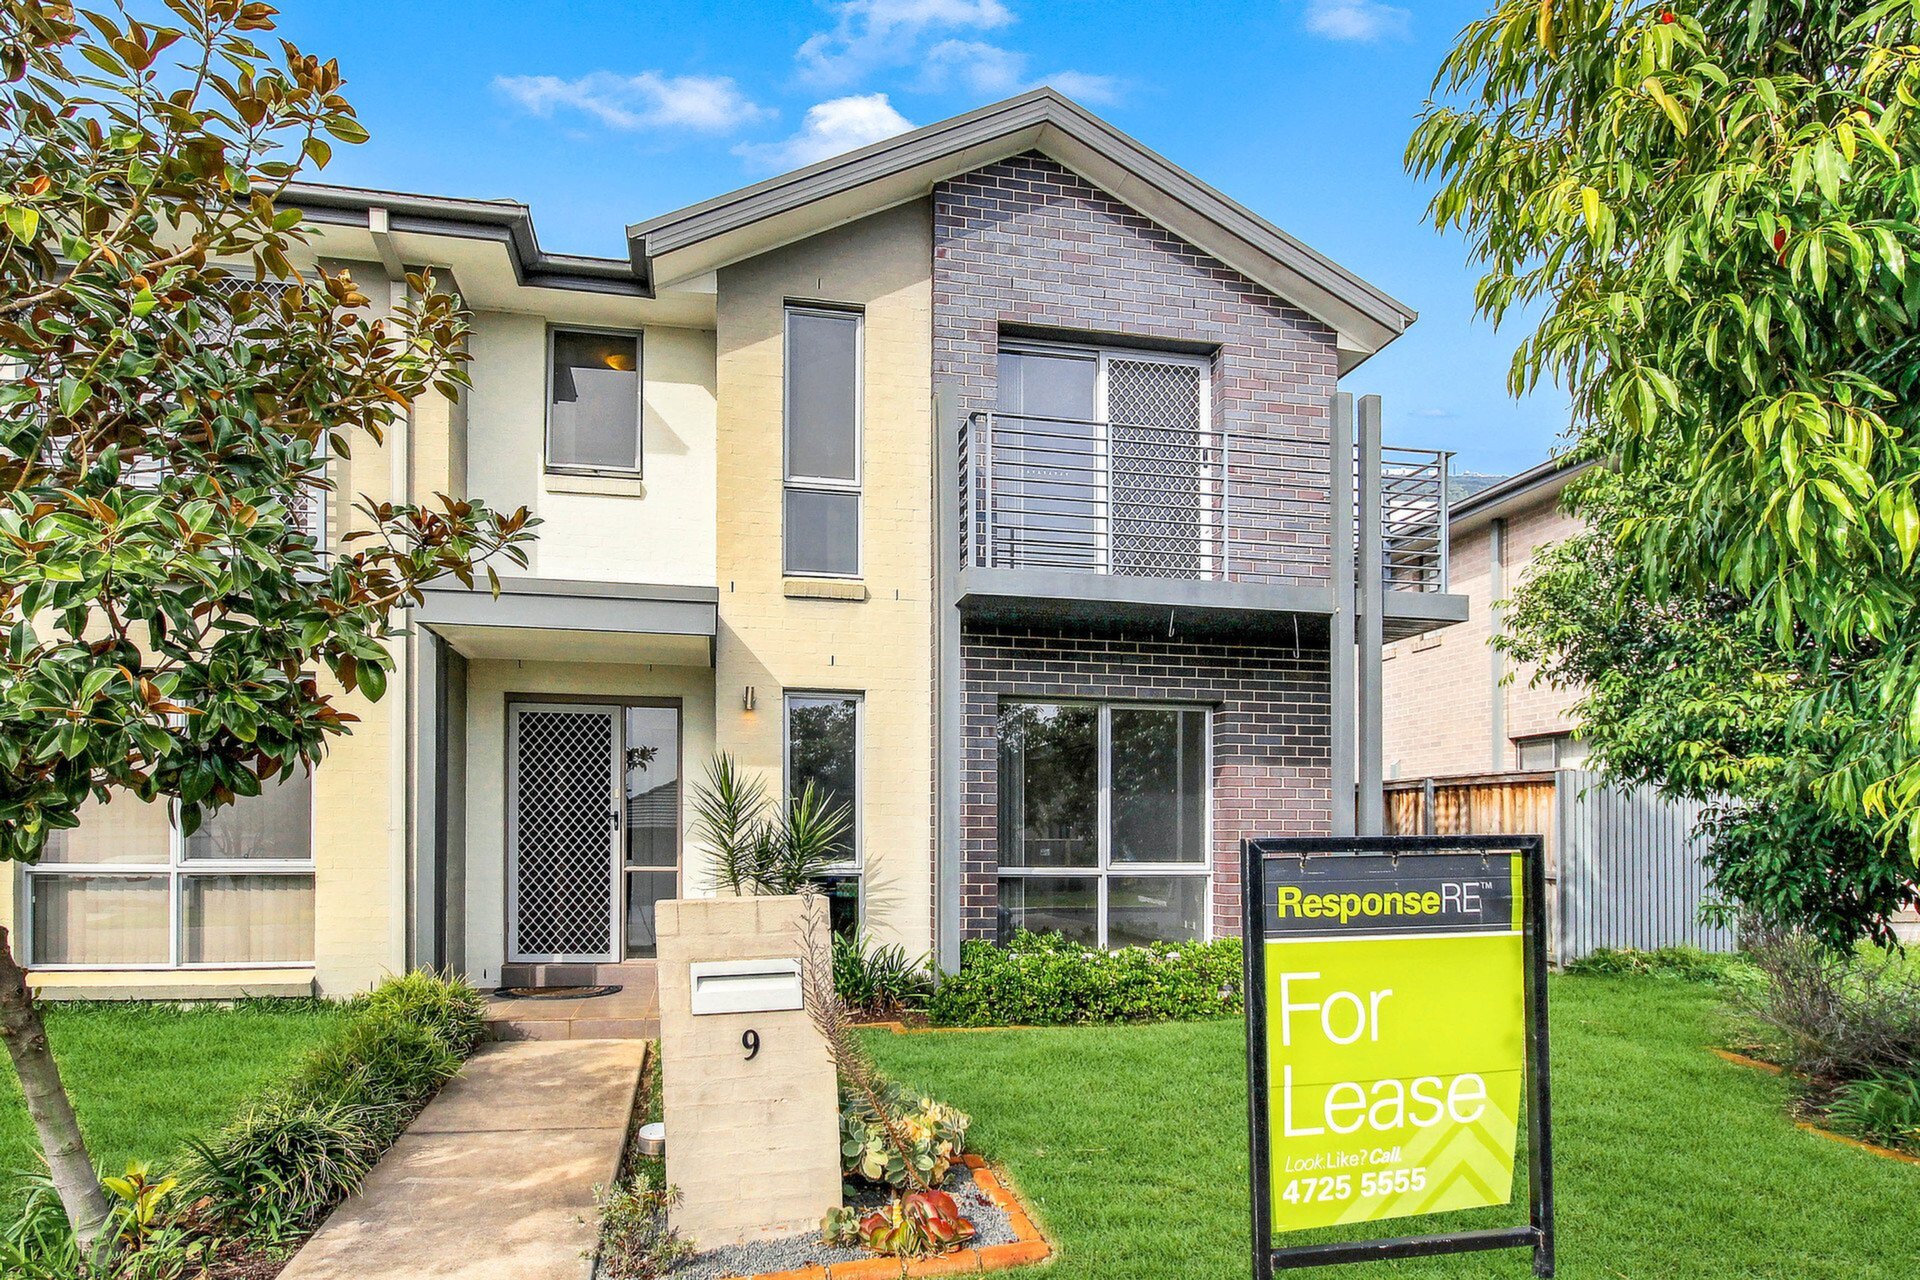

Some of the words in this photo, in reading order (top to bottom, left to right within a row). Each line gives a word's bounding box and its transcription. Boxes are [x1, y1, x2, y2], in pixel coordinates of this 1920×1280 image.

[1280, 971, 1393, 1046] For
[741, 1029, 760, 1061] 9
[1283, 1065, 1487, 1137] Lease
[1326, 1149, 1368, 1169] Like?
[1282, 1174, 1351, 1204] 4725
[1360, 1167, 1427, 1198] 5555
